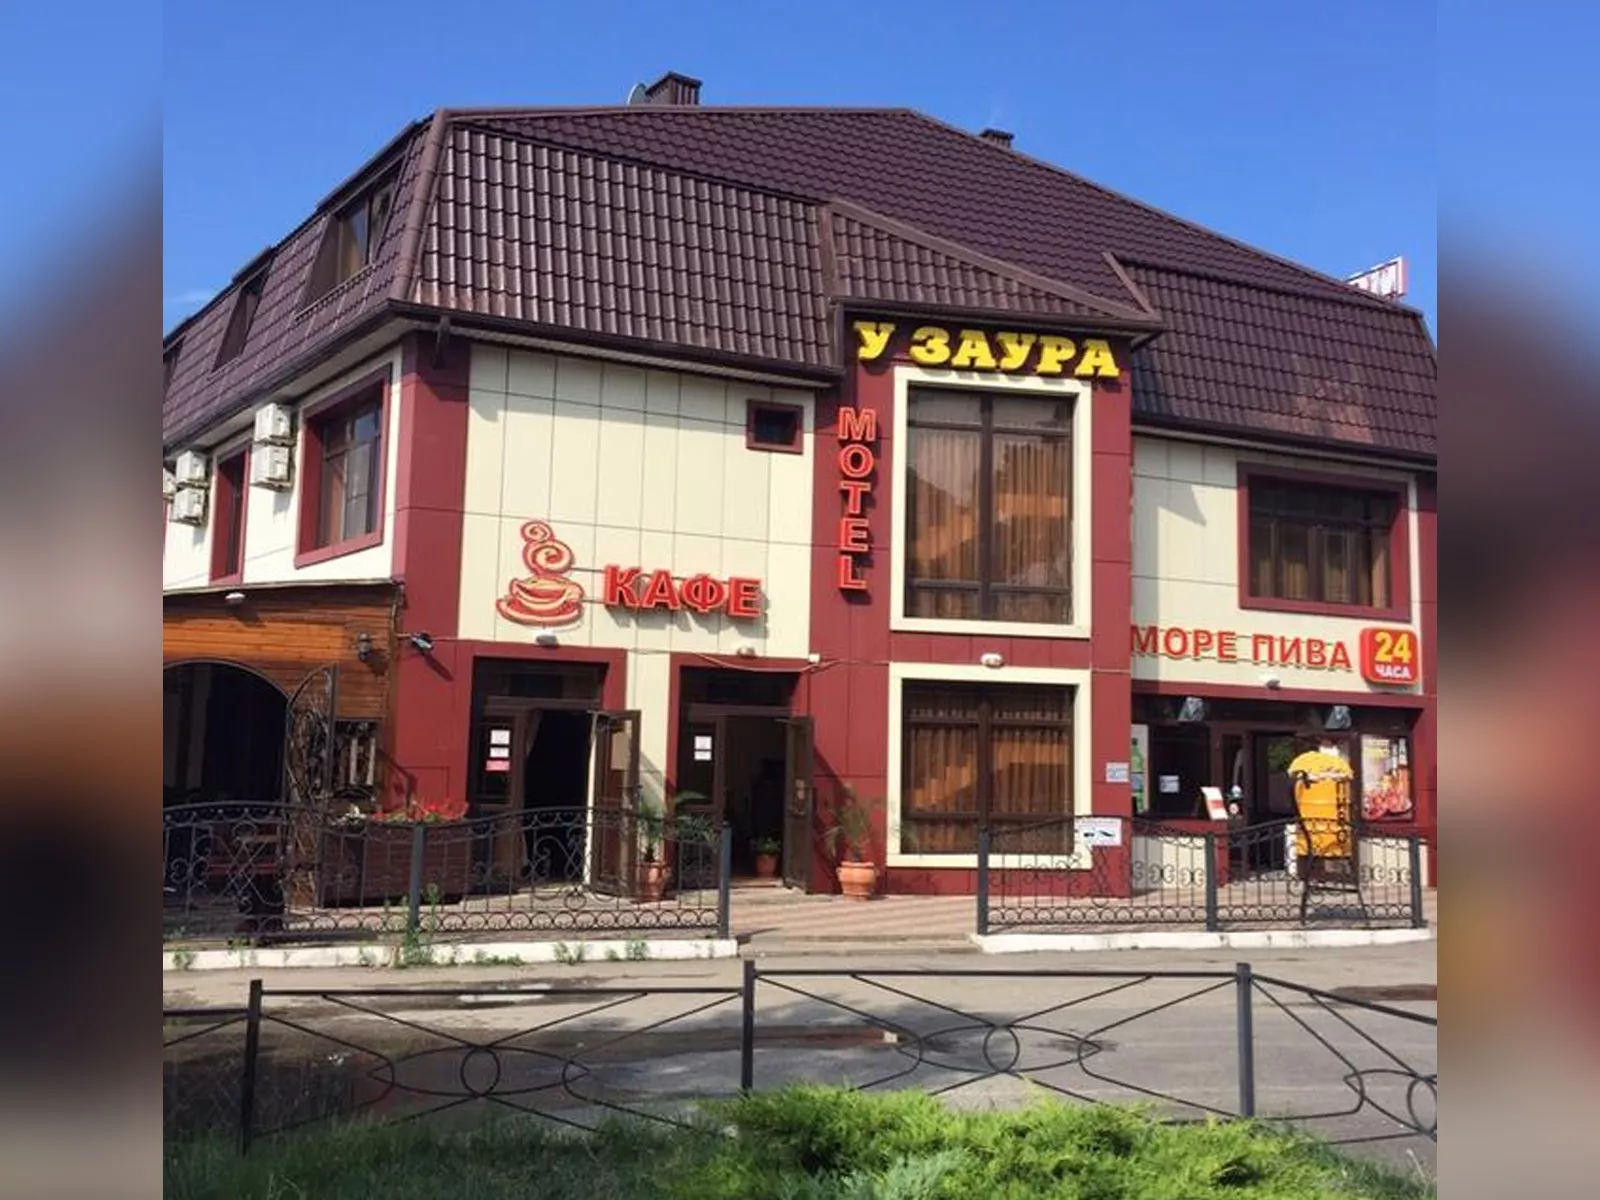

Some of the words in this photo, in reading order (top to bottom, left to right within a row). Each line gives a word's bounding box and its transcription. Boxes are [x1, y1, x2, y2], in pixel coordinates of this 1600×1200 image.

[854, 320, 895, 361] У
[910, 326, 1120, 378] ЗАУРА
[838, 406, 877, 589] MOTEL
[604, 564, 762, 617] КАФЕ
[1131, 625, 1237, 661] МОРЕ
[1251, 633, 1352, 670] ПИВА
[1374, 631, 1412, 664] 24
[1375, 664, 1412, 680] ЧАСА
